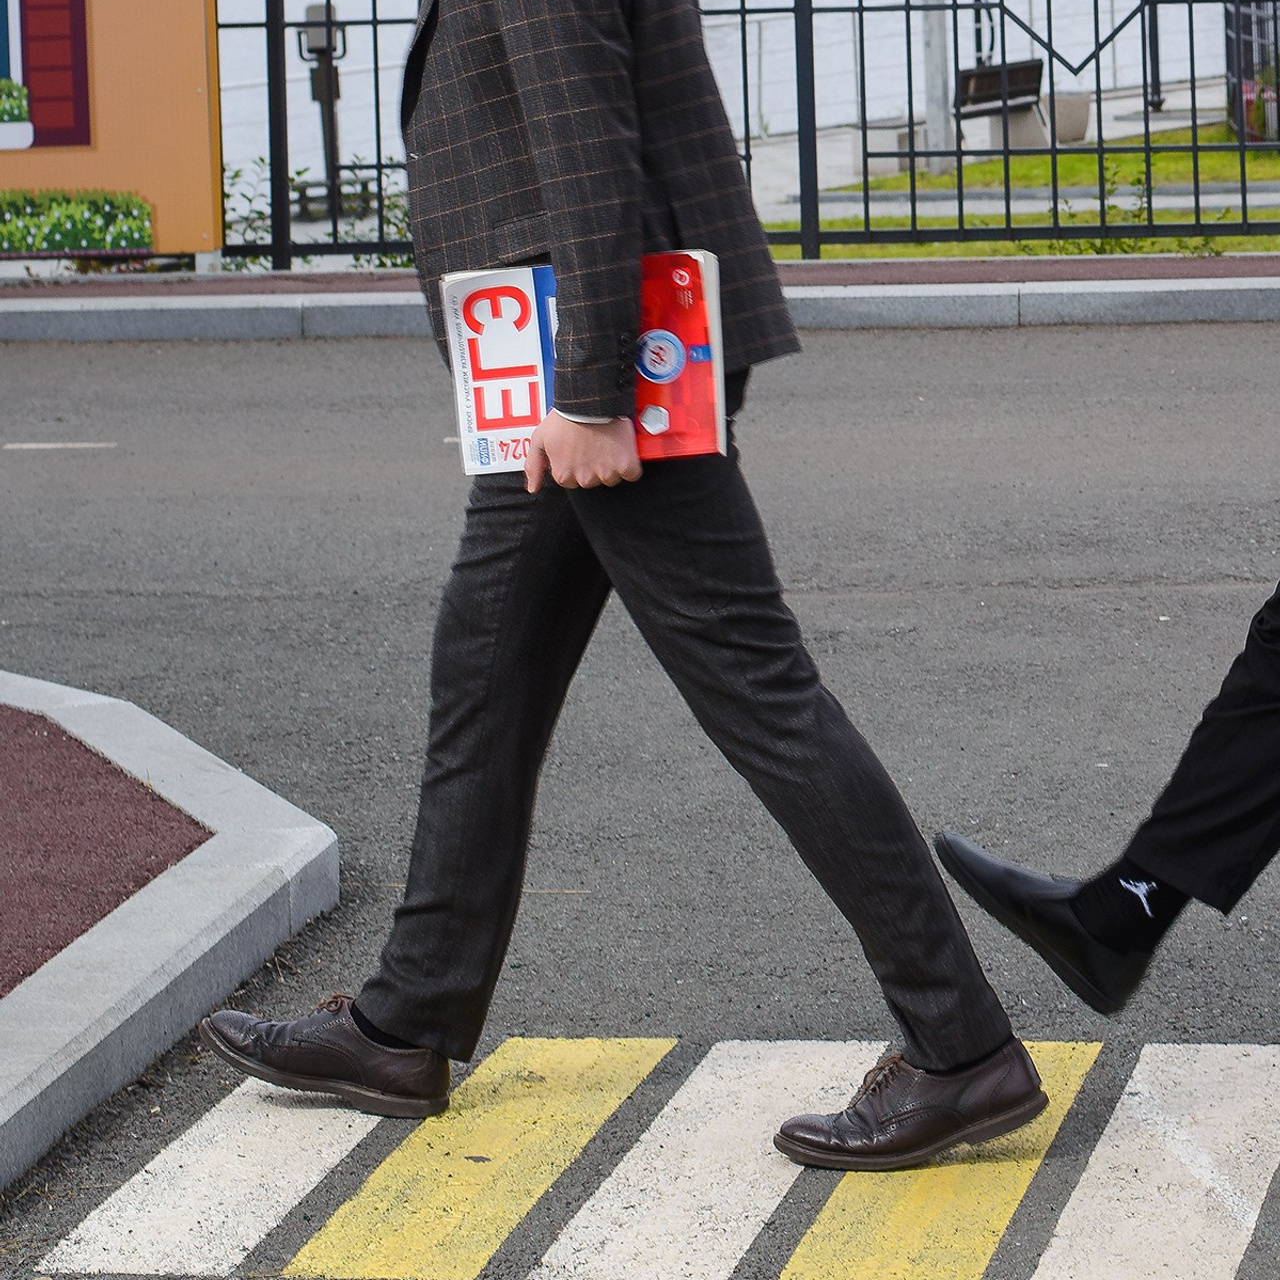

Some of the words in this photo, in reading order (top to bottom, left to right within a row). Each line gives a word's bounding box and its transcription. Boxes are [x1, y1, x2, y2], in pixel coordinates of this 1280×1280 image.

[463, 285, 541, 431] ЕГЭ
[478, 438, 491, 466] ФИПИ
[498, 437, 532, 461] 024
